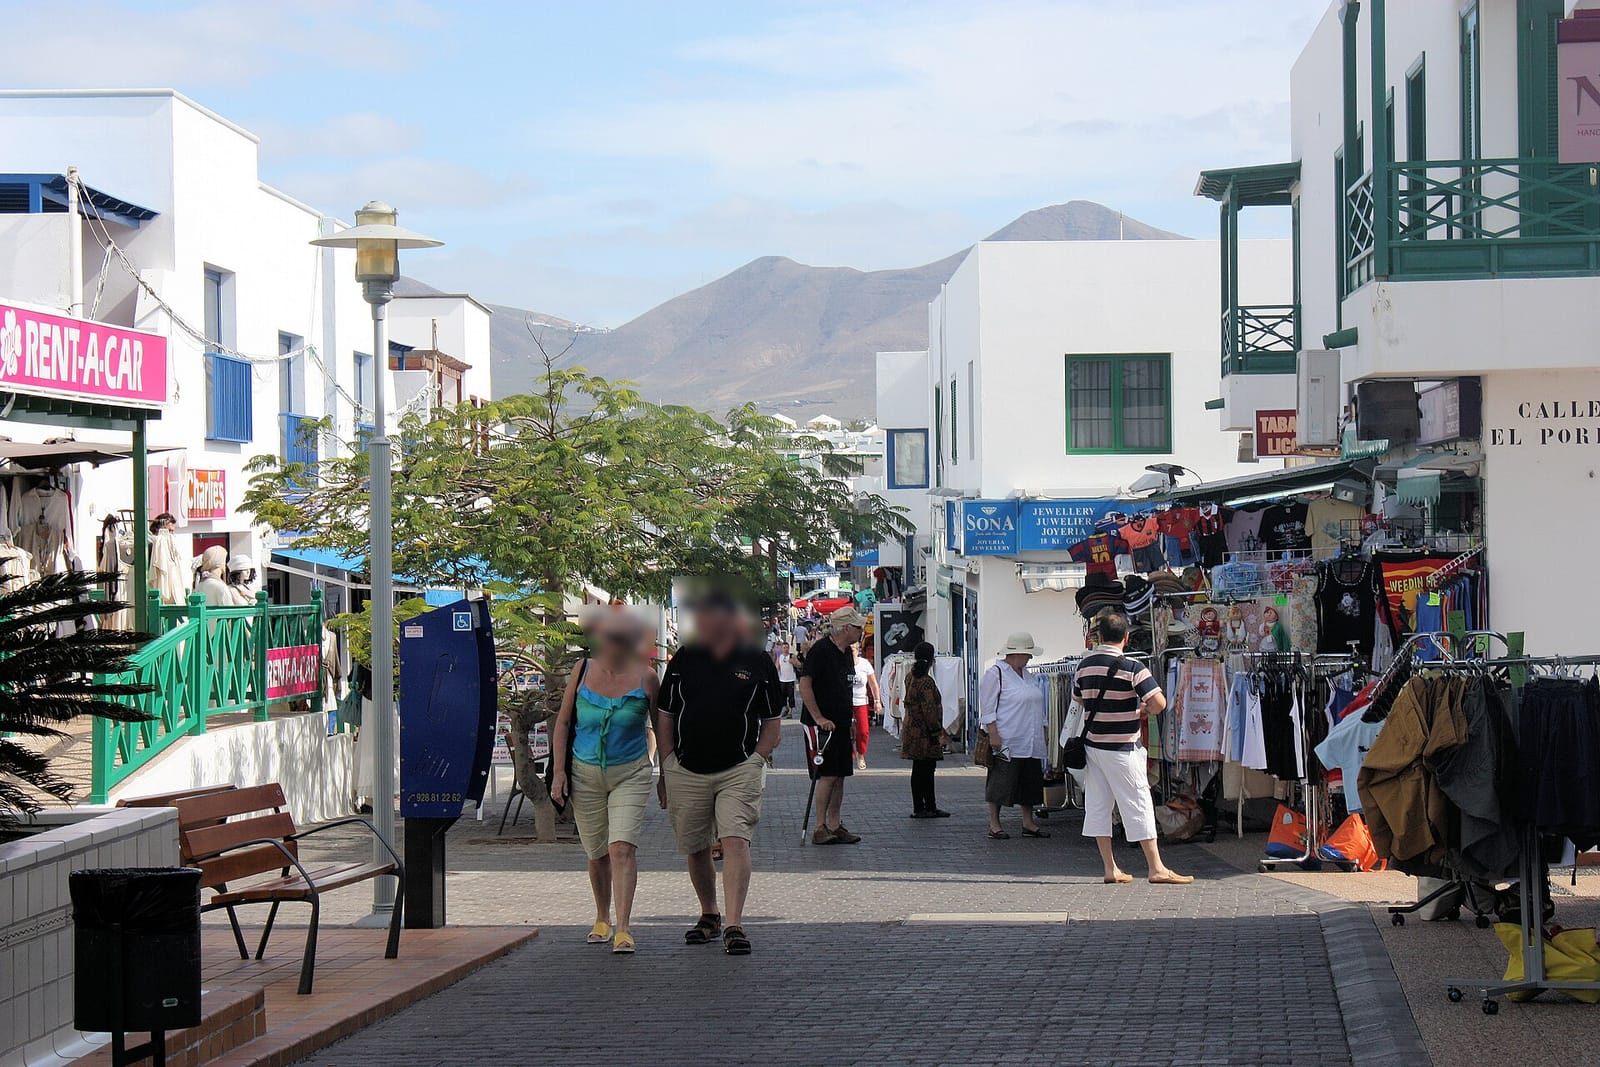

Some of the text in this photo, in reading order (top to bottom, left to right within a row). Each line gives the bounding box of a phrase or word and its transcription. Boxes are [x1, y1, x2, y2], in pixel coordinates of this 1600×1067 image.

[24, 319, 143, 392] RENT-A-CAR
[1519, 400, 1600, 418] CALLE
[1491, 427, 1600, 445] EL POR
[1033, 508, 1095, 516] JEWELLERY
[967, 514, 1015, 531] SONA
[1036, 518, 1092, 526] JUWELIER
[1042, 528, 1086, 536] JOYERIA
[1066, 537, 1086, 545] GOL
[1390, 575, 1424, 593] WEEDIN
[267, 655, 317, 689] RENT-A-CAR
[441, 793, 451, 802] 22
